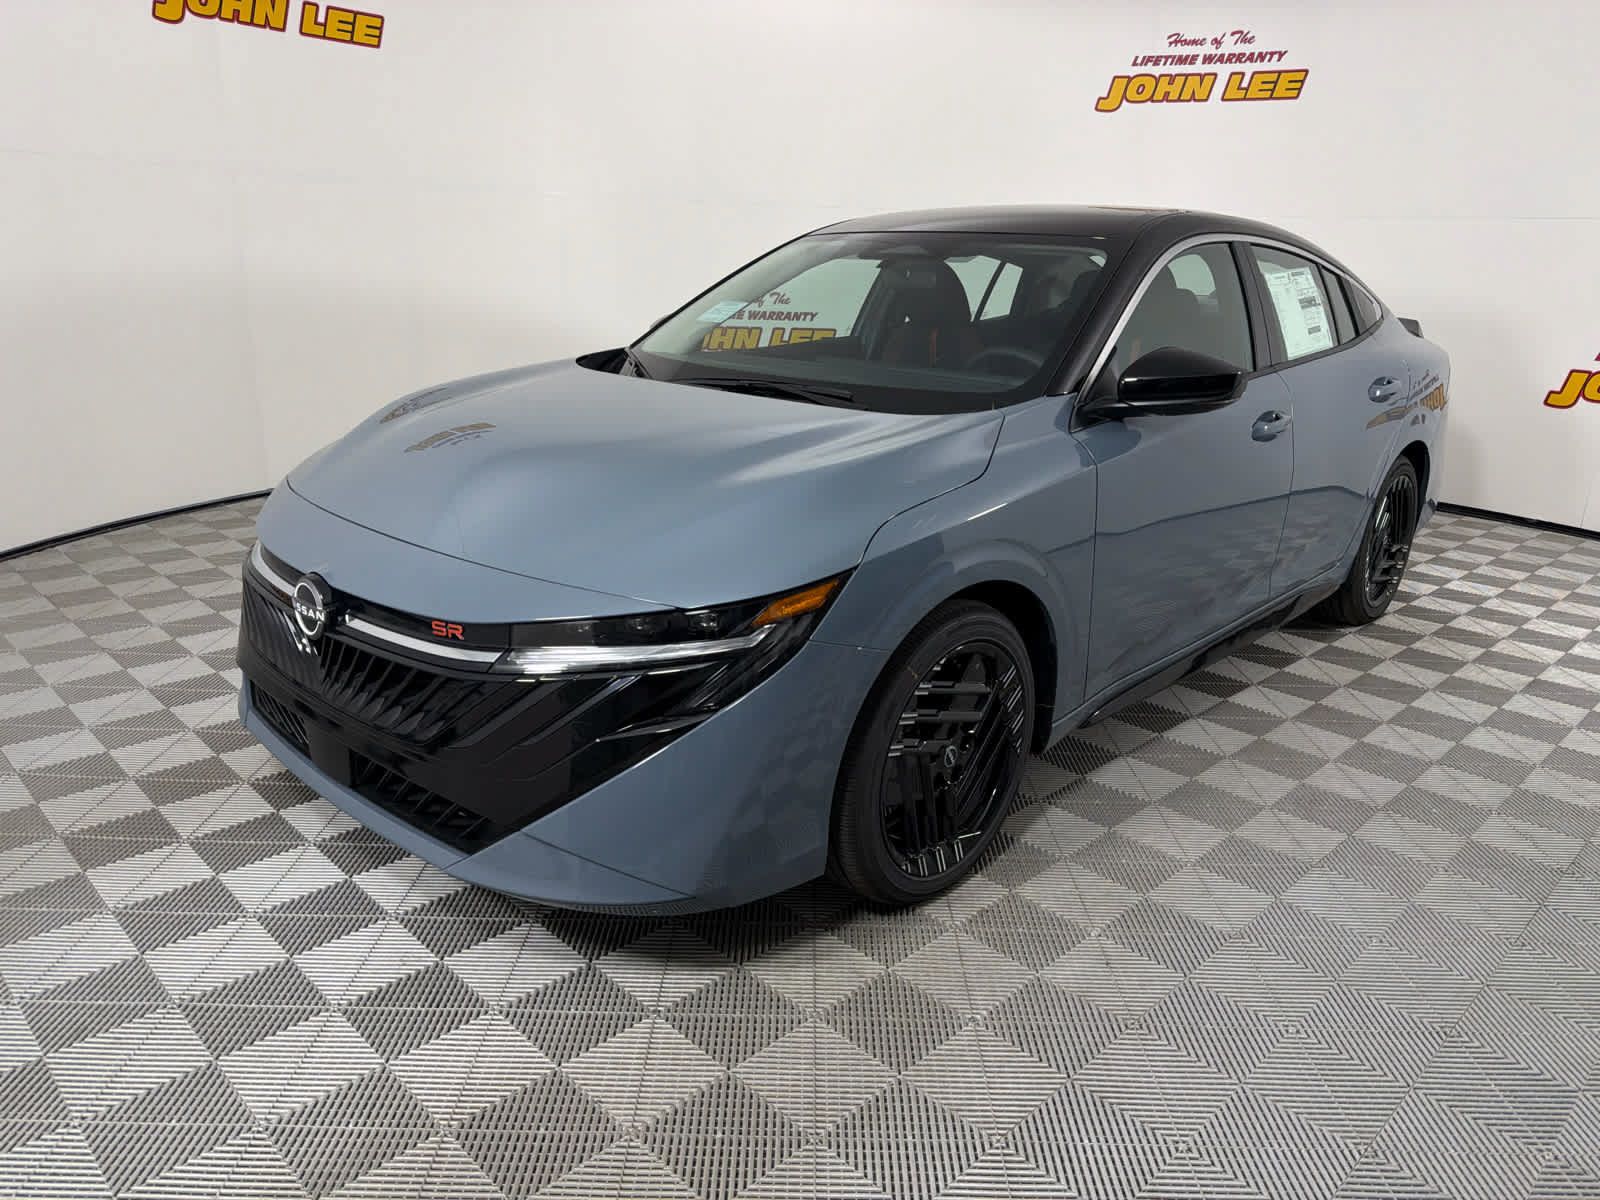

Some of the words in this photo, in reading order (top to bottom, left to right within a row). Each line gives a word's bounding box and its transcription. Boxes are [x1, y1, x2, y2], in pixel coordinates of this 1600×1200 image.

[299, 2, 384, 48] LEE
[1166, 32, 1207, 48] Home
[1211, 32, 1226, 50] of
[1230, 30, 1256, 46] The
[1131, 54, 1200, 67] LIFETIME
[1201, 50, 1288, 65] WARRANTY
[1094, 72, 1218, 112] JOHN
[1221, 68, 1309, 102] LEE
[769, 291, 792, 305] The
[747, 310, 818, 322] WARRANTY
[431, 620, 465, 640] SR
